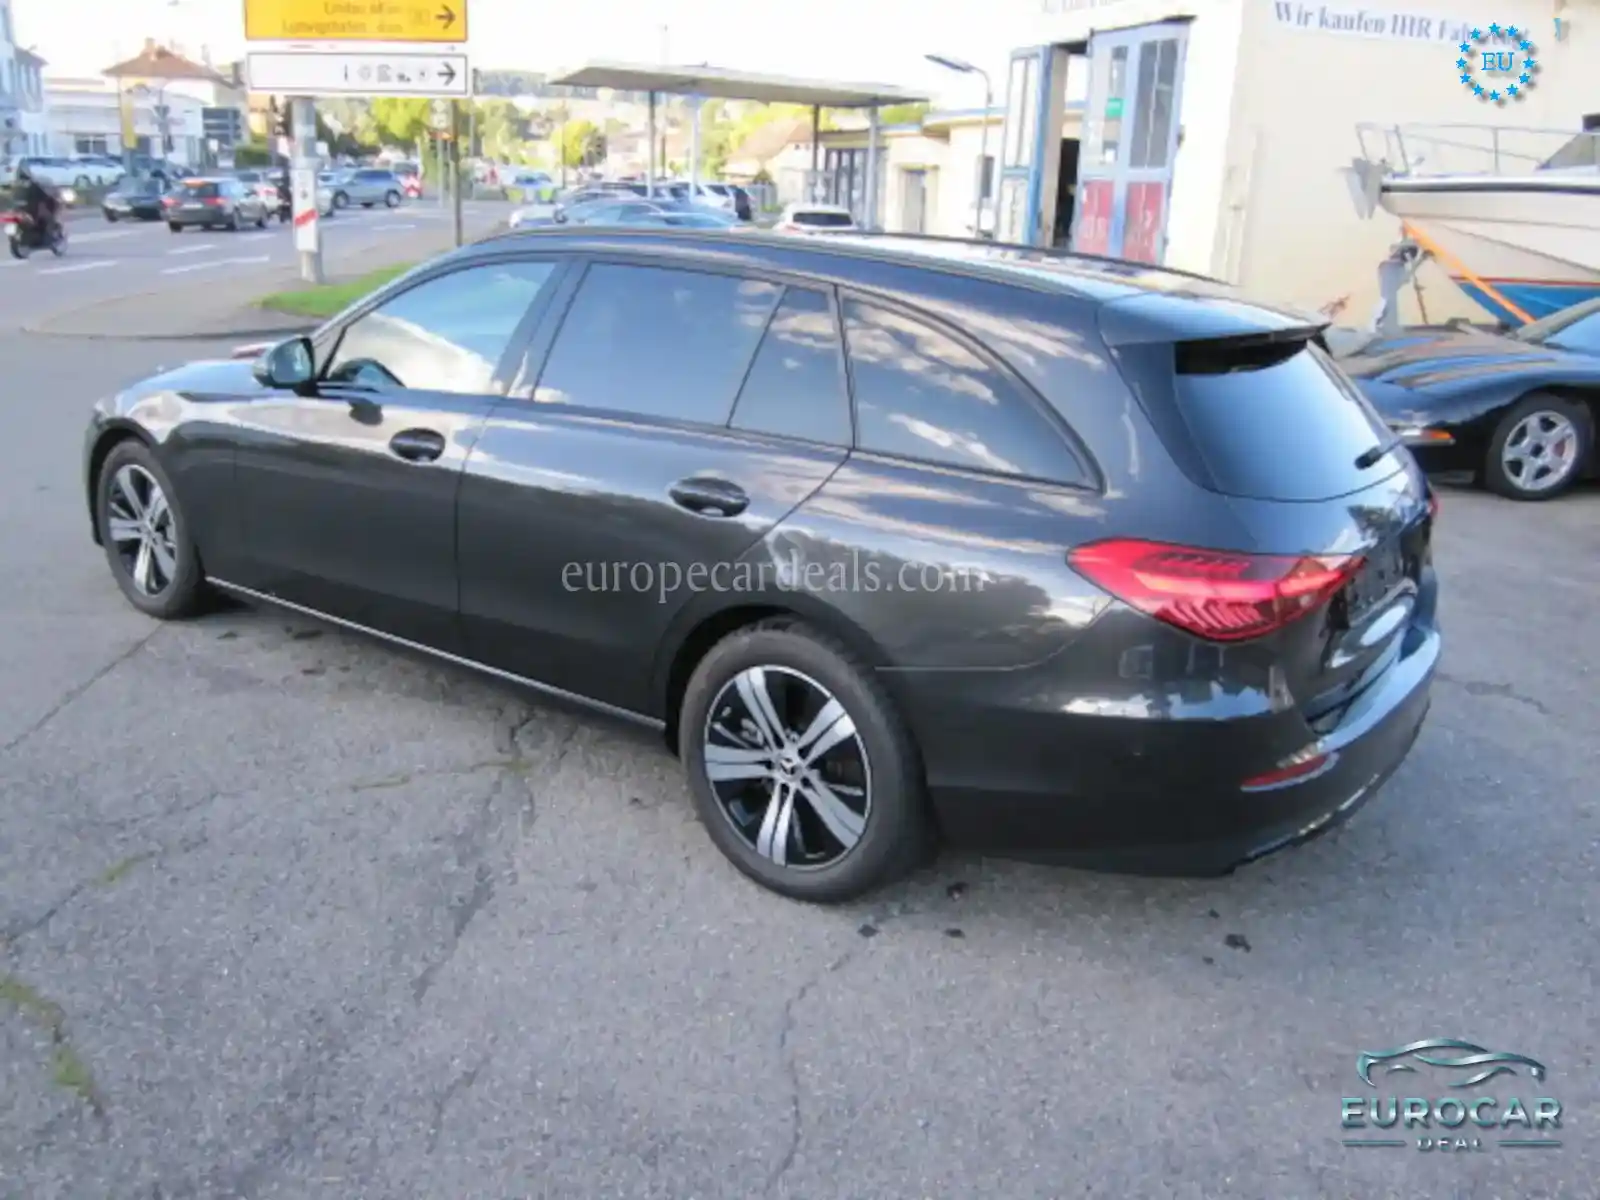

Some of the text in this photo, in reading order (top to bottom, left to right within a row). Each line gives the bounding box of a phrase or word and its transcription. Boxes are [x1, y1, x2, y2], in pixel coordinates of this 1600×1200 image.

[1275, 1, 1313, 27] Wir
[1319, 5, 1386, 34] kaufen
[1391, 14, 1431, 39] IHR
